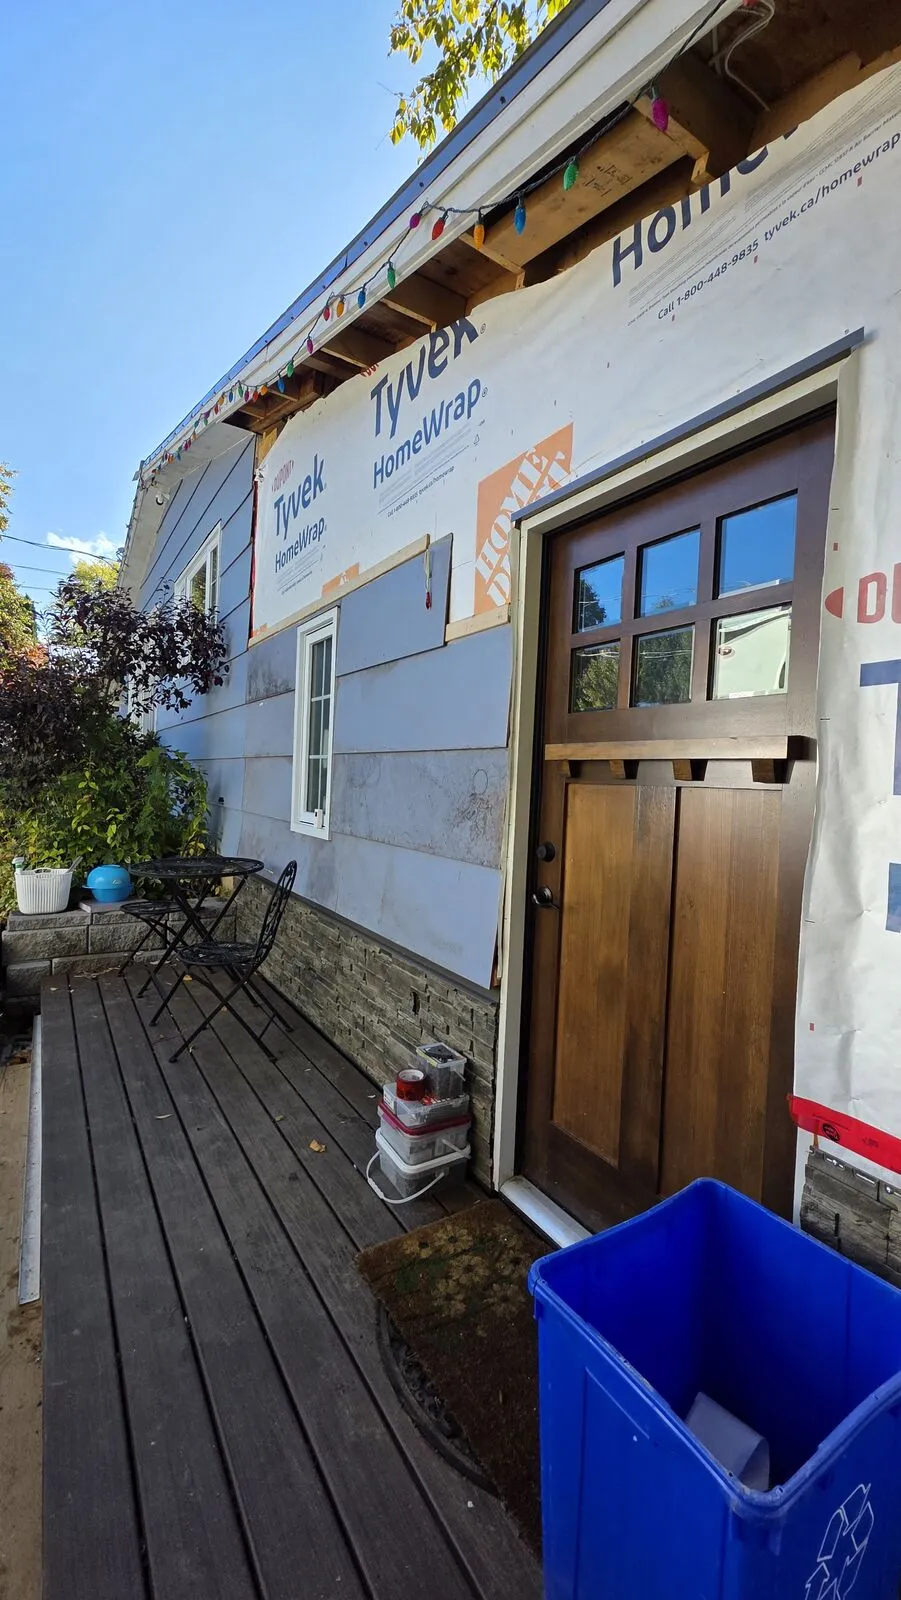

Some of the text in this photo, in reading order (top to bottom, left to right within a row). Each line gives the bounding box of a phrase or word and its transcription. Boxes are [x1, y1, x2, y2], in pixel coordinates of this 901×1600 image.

[658, 300, 675, 320] Call
[676, 238, 759, 306] 1-800-448-9835
[764, 132, 901, 242] tyvek.ca/homewrap
[374, 378, 481, 490] HomeWrap
[274, 453, 325, 541] Tyvek
[275, 517, 325, 573] HomeWrap
